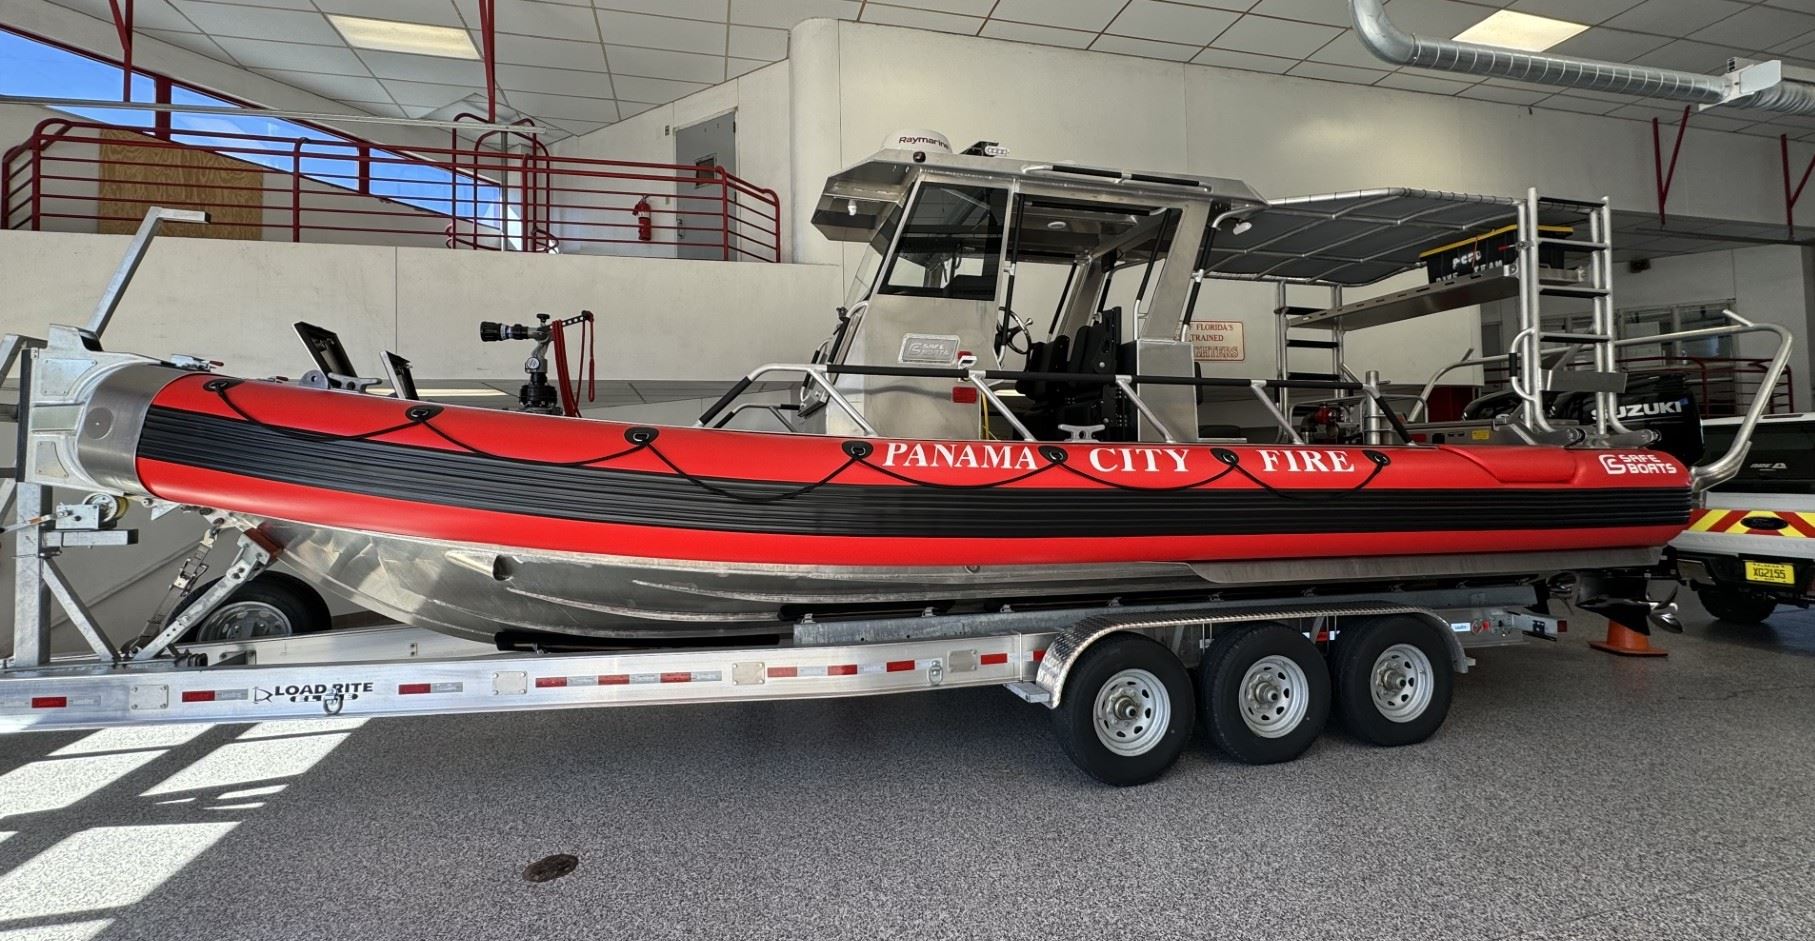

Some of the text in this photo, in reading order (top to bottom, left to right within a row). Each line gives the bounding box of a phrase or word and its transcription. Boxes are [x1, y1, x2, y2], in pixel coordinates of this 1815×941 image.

[899, 136, 949, 150] Raymarine
[1196, 323, 1233, 331] FLORIDA'S
[1191, 334, 1224, 342] TRAINED
[883, 442, 1354, 472] PANAMA CITY FIRE
[1617, 454, 1661, 463] SAFE
[1626, 463, 1677, 474] BOATS
[1753, 567, 1786, 580] XG2155
[275, 682, 374, 696] LOAD RITE
